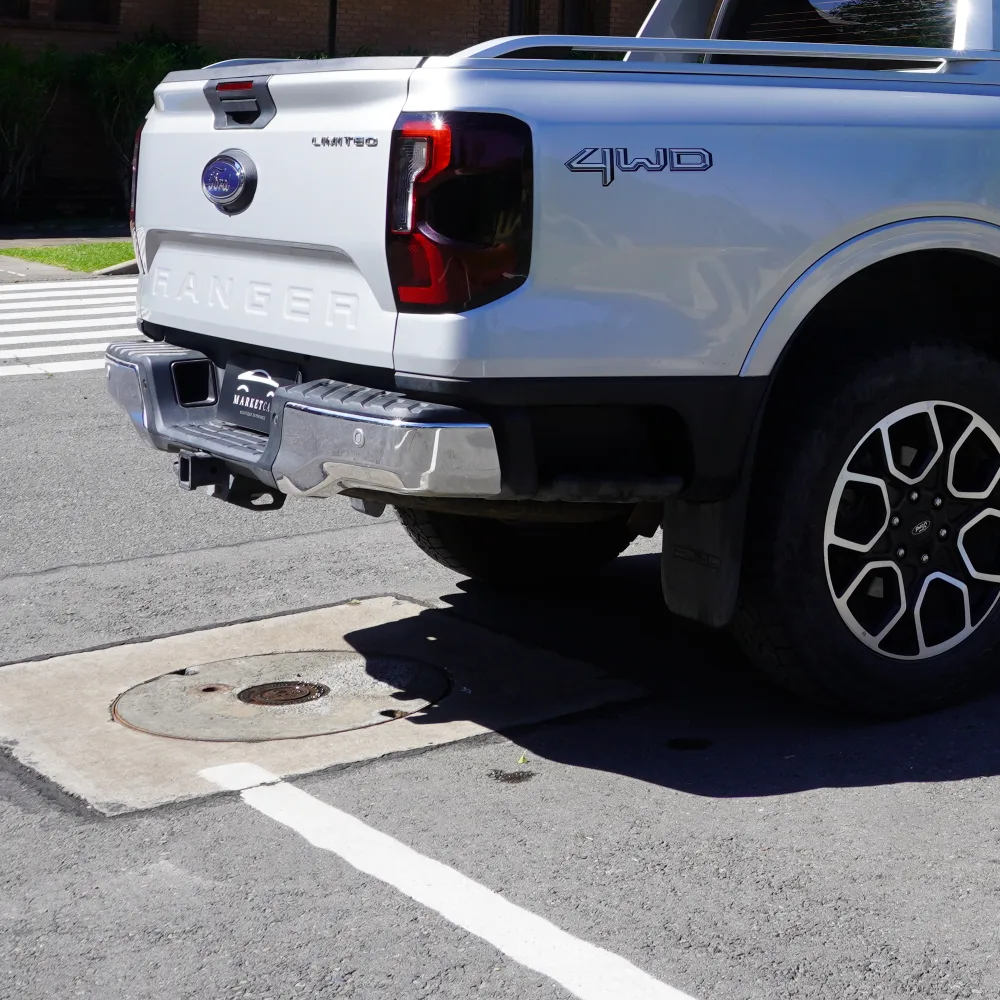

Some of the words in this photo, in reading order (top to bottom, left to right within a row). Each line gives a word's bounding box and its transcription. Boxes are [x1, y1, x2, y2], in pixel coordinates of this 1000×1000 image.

[311, 136, 379, 148] LIMITED
[206, 165, 231, 192] Ford
[563, 147, 714, 187] 4WD
[151, 265, 360, 331] RANGER
[232, 394, 272, 413] MARKETCA
